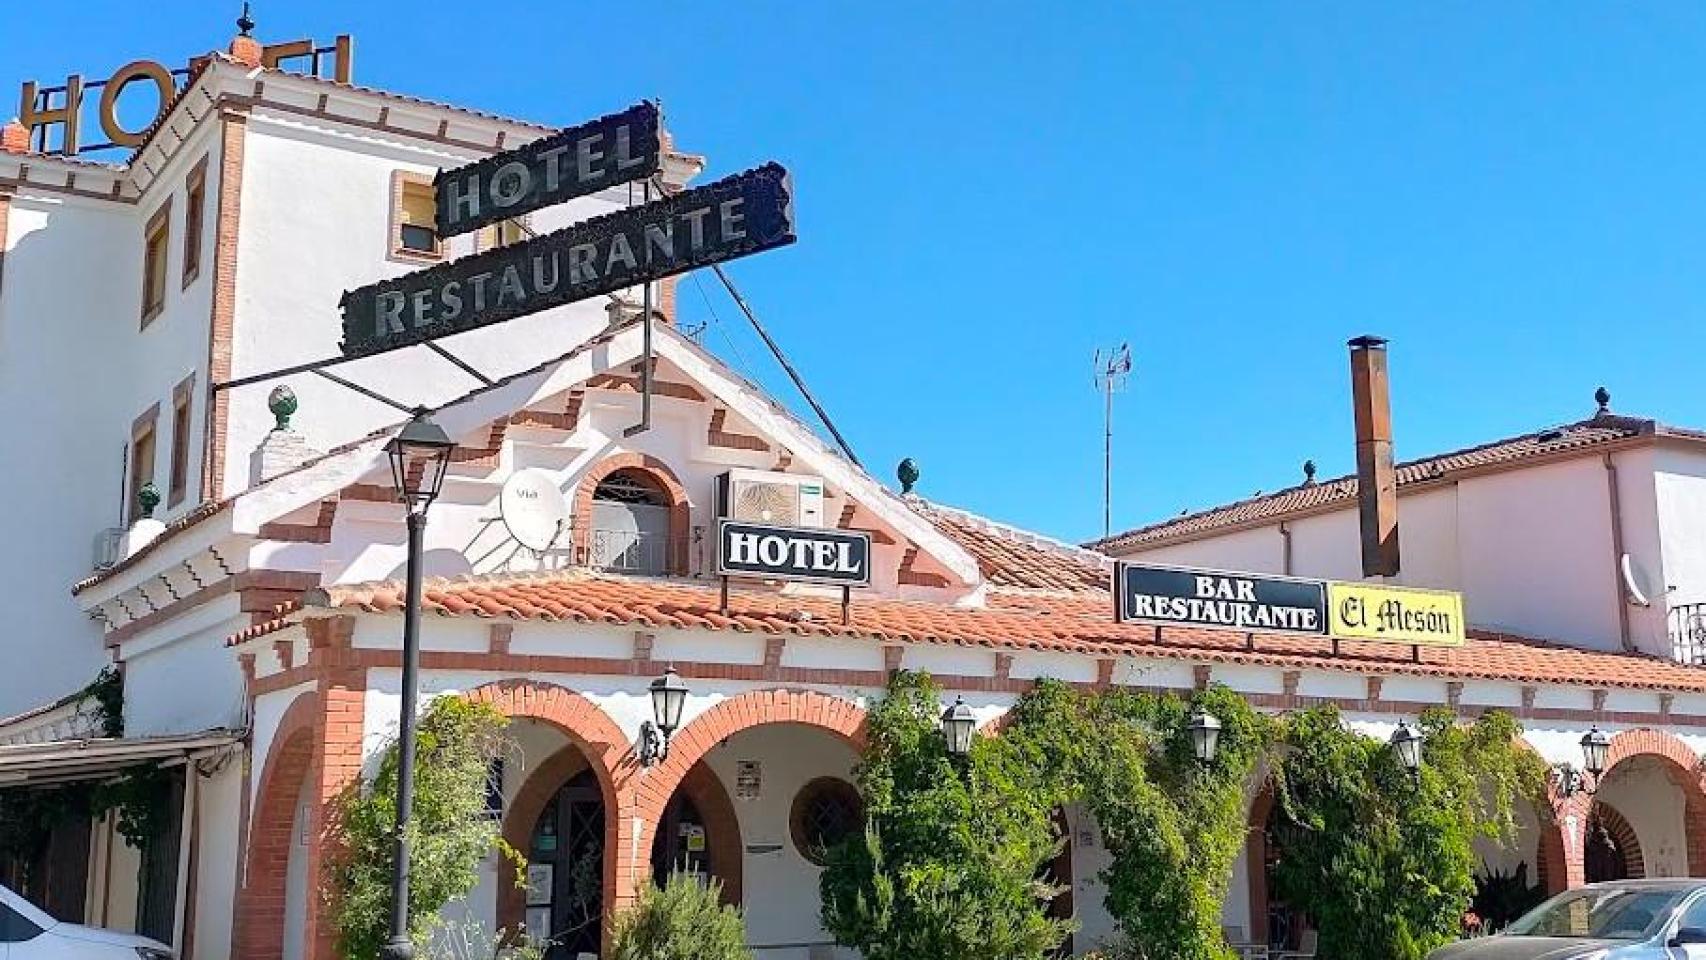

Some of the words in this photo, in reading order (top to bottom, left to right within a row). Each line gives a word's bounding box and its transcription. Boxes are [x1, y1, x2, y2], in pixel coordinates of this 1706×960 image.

[447, 125, 645, 225] HOTEL
[374, 197, 747, 338] RESTAURANTE
[728, 532, 861, 573] HOTEL
[1196, 575, 1257, 602] BAR
[1135, 593, 1318, 631] RESTAURANTE
[1340, 596, 1367, 628] El
[1376, 599, 1451, 634] Mesón
